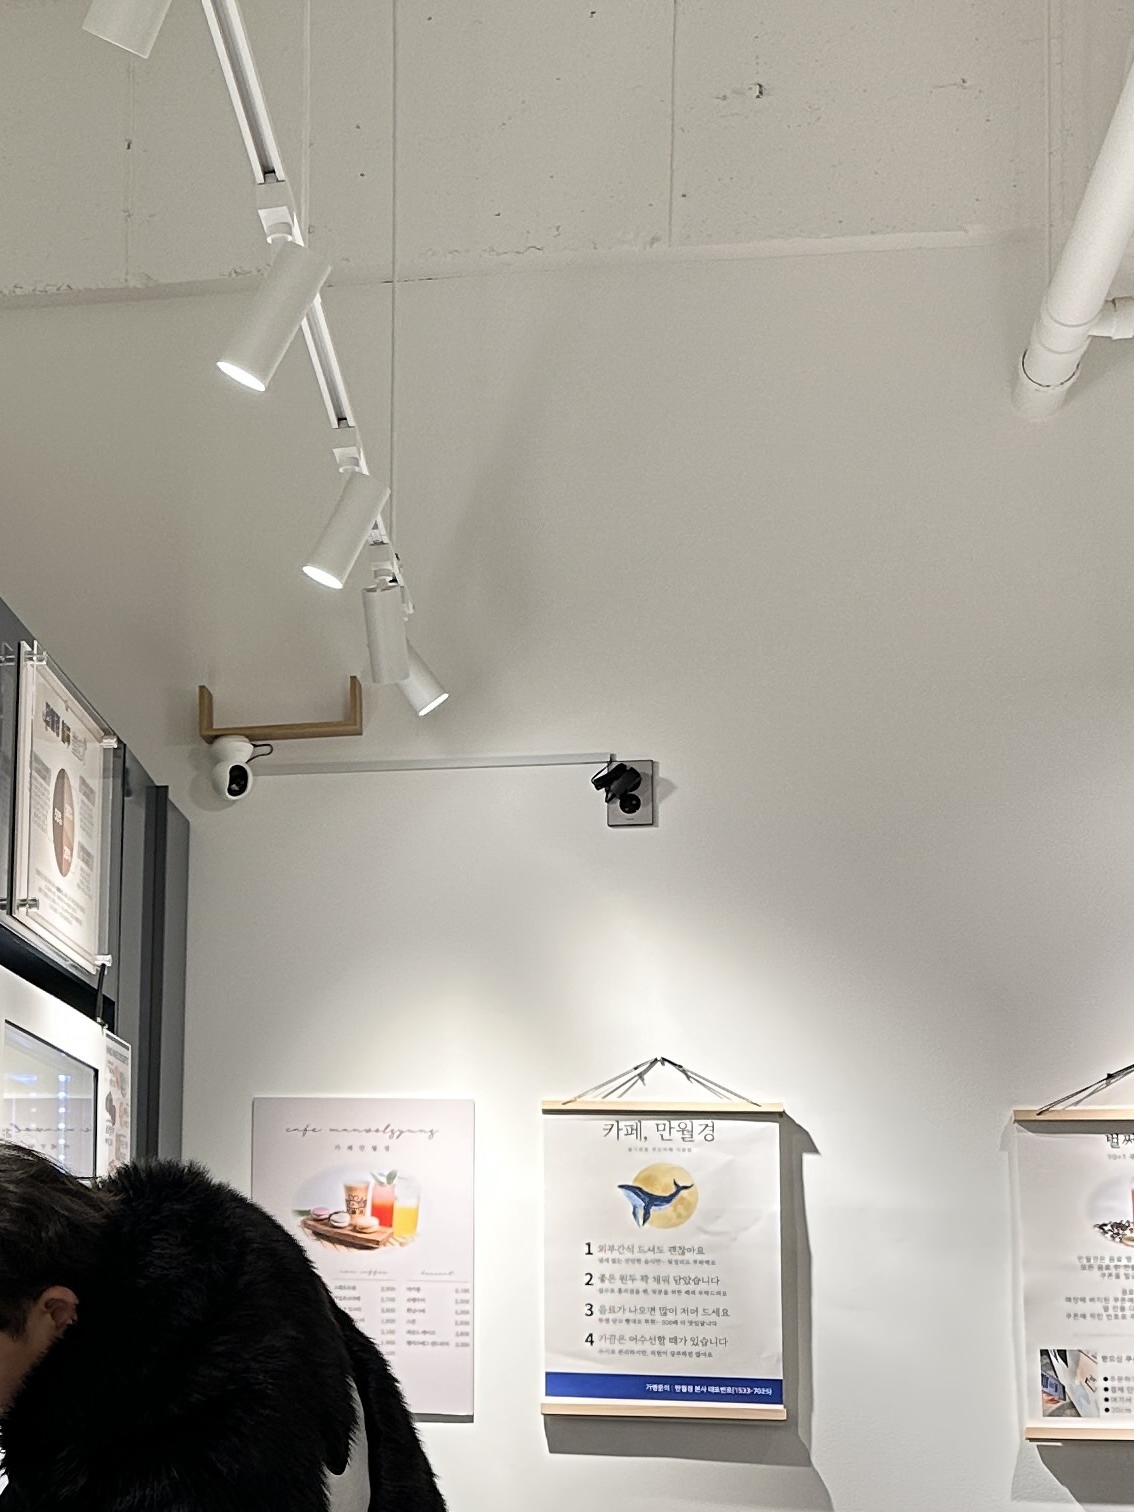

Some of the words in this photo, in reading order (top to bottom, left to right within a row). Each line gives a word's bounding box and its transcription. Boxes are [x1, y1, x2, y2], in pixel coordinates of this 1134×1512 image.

[286, 1123, 322, 1137] cafe
[603, 1119, 648, 1142] 카페,
[655, 1119, 715, 1142] 만월경
[584, 1242, 594, 1256] 1
[597, 1244, 634, 1255] 외부간식
[637, 1245, 665, 1255] 드셔도
[667, 1245, 705, 1256] 괜찮아요
[584, 1273, 594, 1286] 2
[597, 1273, 616, 1285] 좋은
[619, 1274, 637, 1285] 원두
[652, 1275, 670, 1285] 채워
[673, 1275, 720, 1286] 담았습니다
[584, 1303, 594, 1316] 3
[597, 1304, 626, 1315] 음료가
[629, 1306, 656, 1316] 나오면
[659, 1306, 677, 1316] 많이
[680, 1307, 698, 1317] 저어
[702, 1307, 730, 1317] 드세요
[584, 1333, 595, 1346] 4
[597, 1334, 626, 1345] 가끔은
[629, 1335, 666, 1346] 어수선할
[669, 1336, 687, 1346] 때가
[690, 1336, 728, 1347] 있습니다
[694, 1385, 707, 1393] 본사
